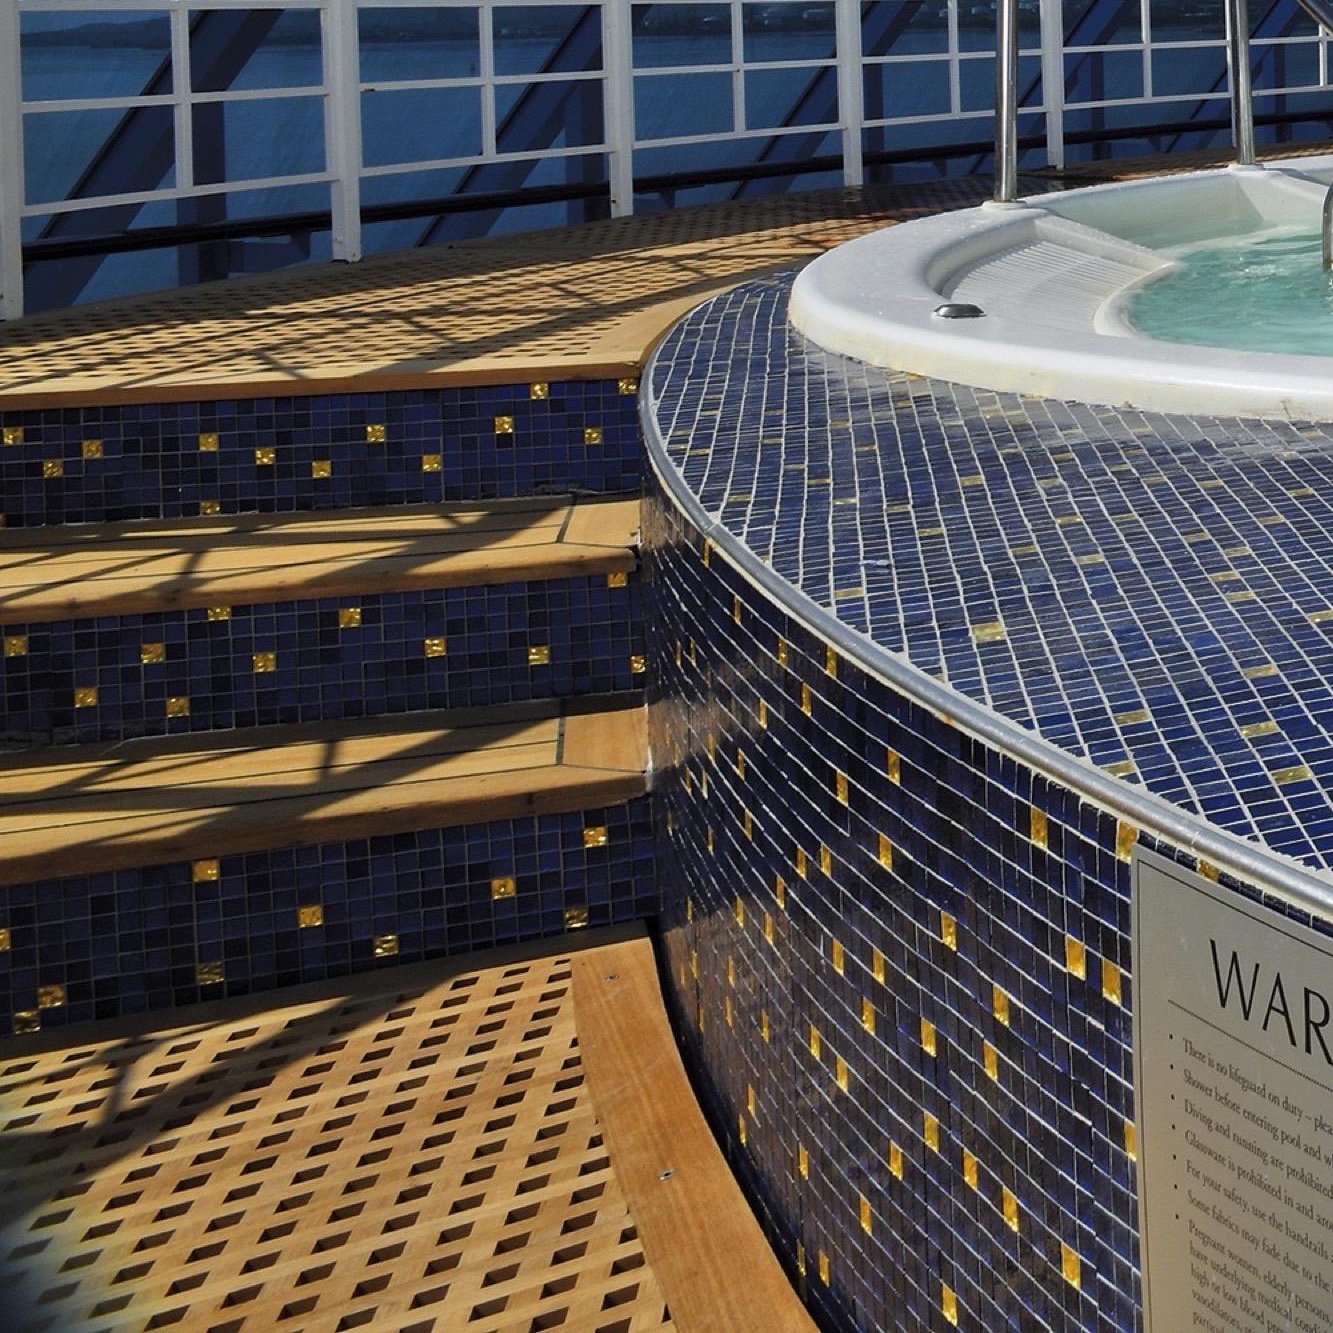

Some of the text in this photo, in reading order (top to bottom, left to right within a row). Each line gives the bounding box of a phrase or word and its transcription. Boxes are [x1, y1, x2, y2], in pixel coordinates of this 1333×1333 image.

[1183, 1037, 1206, 1064] There
[1208, 1052, 1215, 1068] is
[1216, 1063, 1228, 1076] no
[1229, 1064, 1266, 1098] lifeguard
[1268, 1092, 1280, 1106] on
[1282, 1096, 1303, 1122] duty
[1184, 1069, 1213, 1097] Shower
[1215, 1087, 1241, 1114] before
[1243, 1109, 1279, 1141] entering
[1281, 1130, 1301, 1150] pool
[1303, 1143, 1321, 1161] and
[1184, 1099, 1213, 1132] Diving
[1214, 1123, 1230, 1139] and
[1232, 1133, 1268, 1166] running
[1270, 1155, 1284, 1171] are
[1185, 1130, 1226, 1167] Glassware
[1228, 1155, 1236, 1172] is
[1237, 1166, 1282, 1201] prohibited
[1284, 1189, 1294, 1208] in
[1296, 1202, 1314, 1221] and
[1187, 1159, 1201, 1179] For
[1202, 1173, 1221, 1192] your
[1223, 1187, 1250, 1213] safety,
[1251, 1204, 1266, 1222] use
[1268, 1212, 1284, 1233] the
[1285, 1220, 1329, 1260] handrails
[1187, 1189, 1211, 1216] Some
[1212, 1205, 1240, 1234] fabrics
[1241, 1229, 1260, 1251] may
[1262, 1237, 1282, 1261] fade
[1283, 1252, 1301, 1274] due
[1302, 1267, 1313, 1281] to
[1314, 1272, 1330, 1293] the
[1189, 1219, 1226, 1255] Pregnant
[1227, 1249, 1262, 1280] women,
[1263, 1271, 1293, 1302] elderly
[1295, 1294, 1333, 1327] persons,
[1190, 1240, 1293, 1322] have underlying medical
[1191, 1262, 1265, 1325] high or low blood
